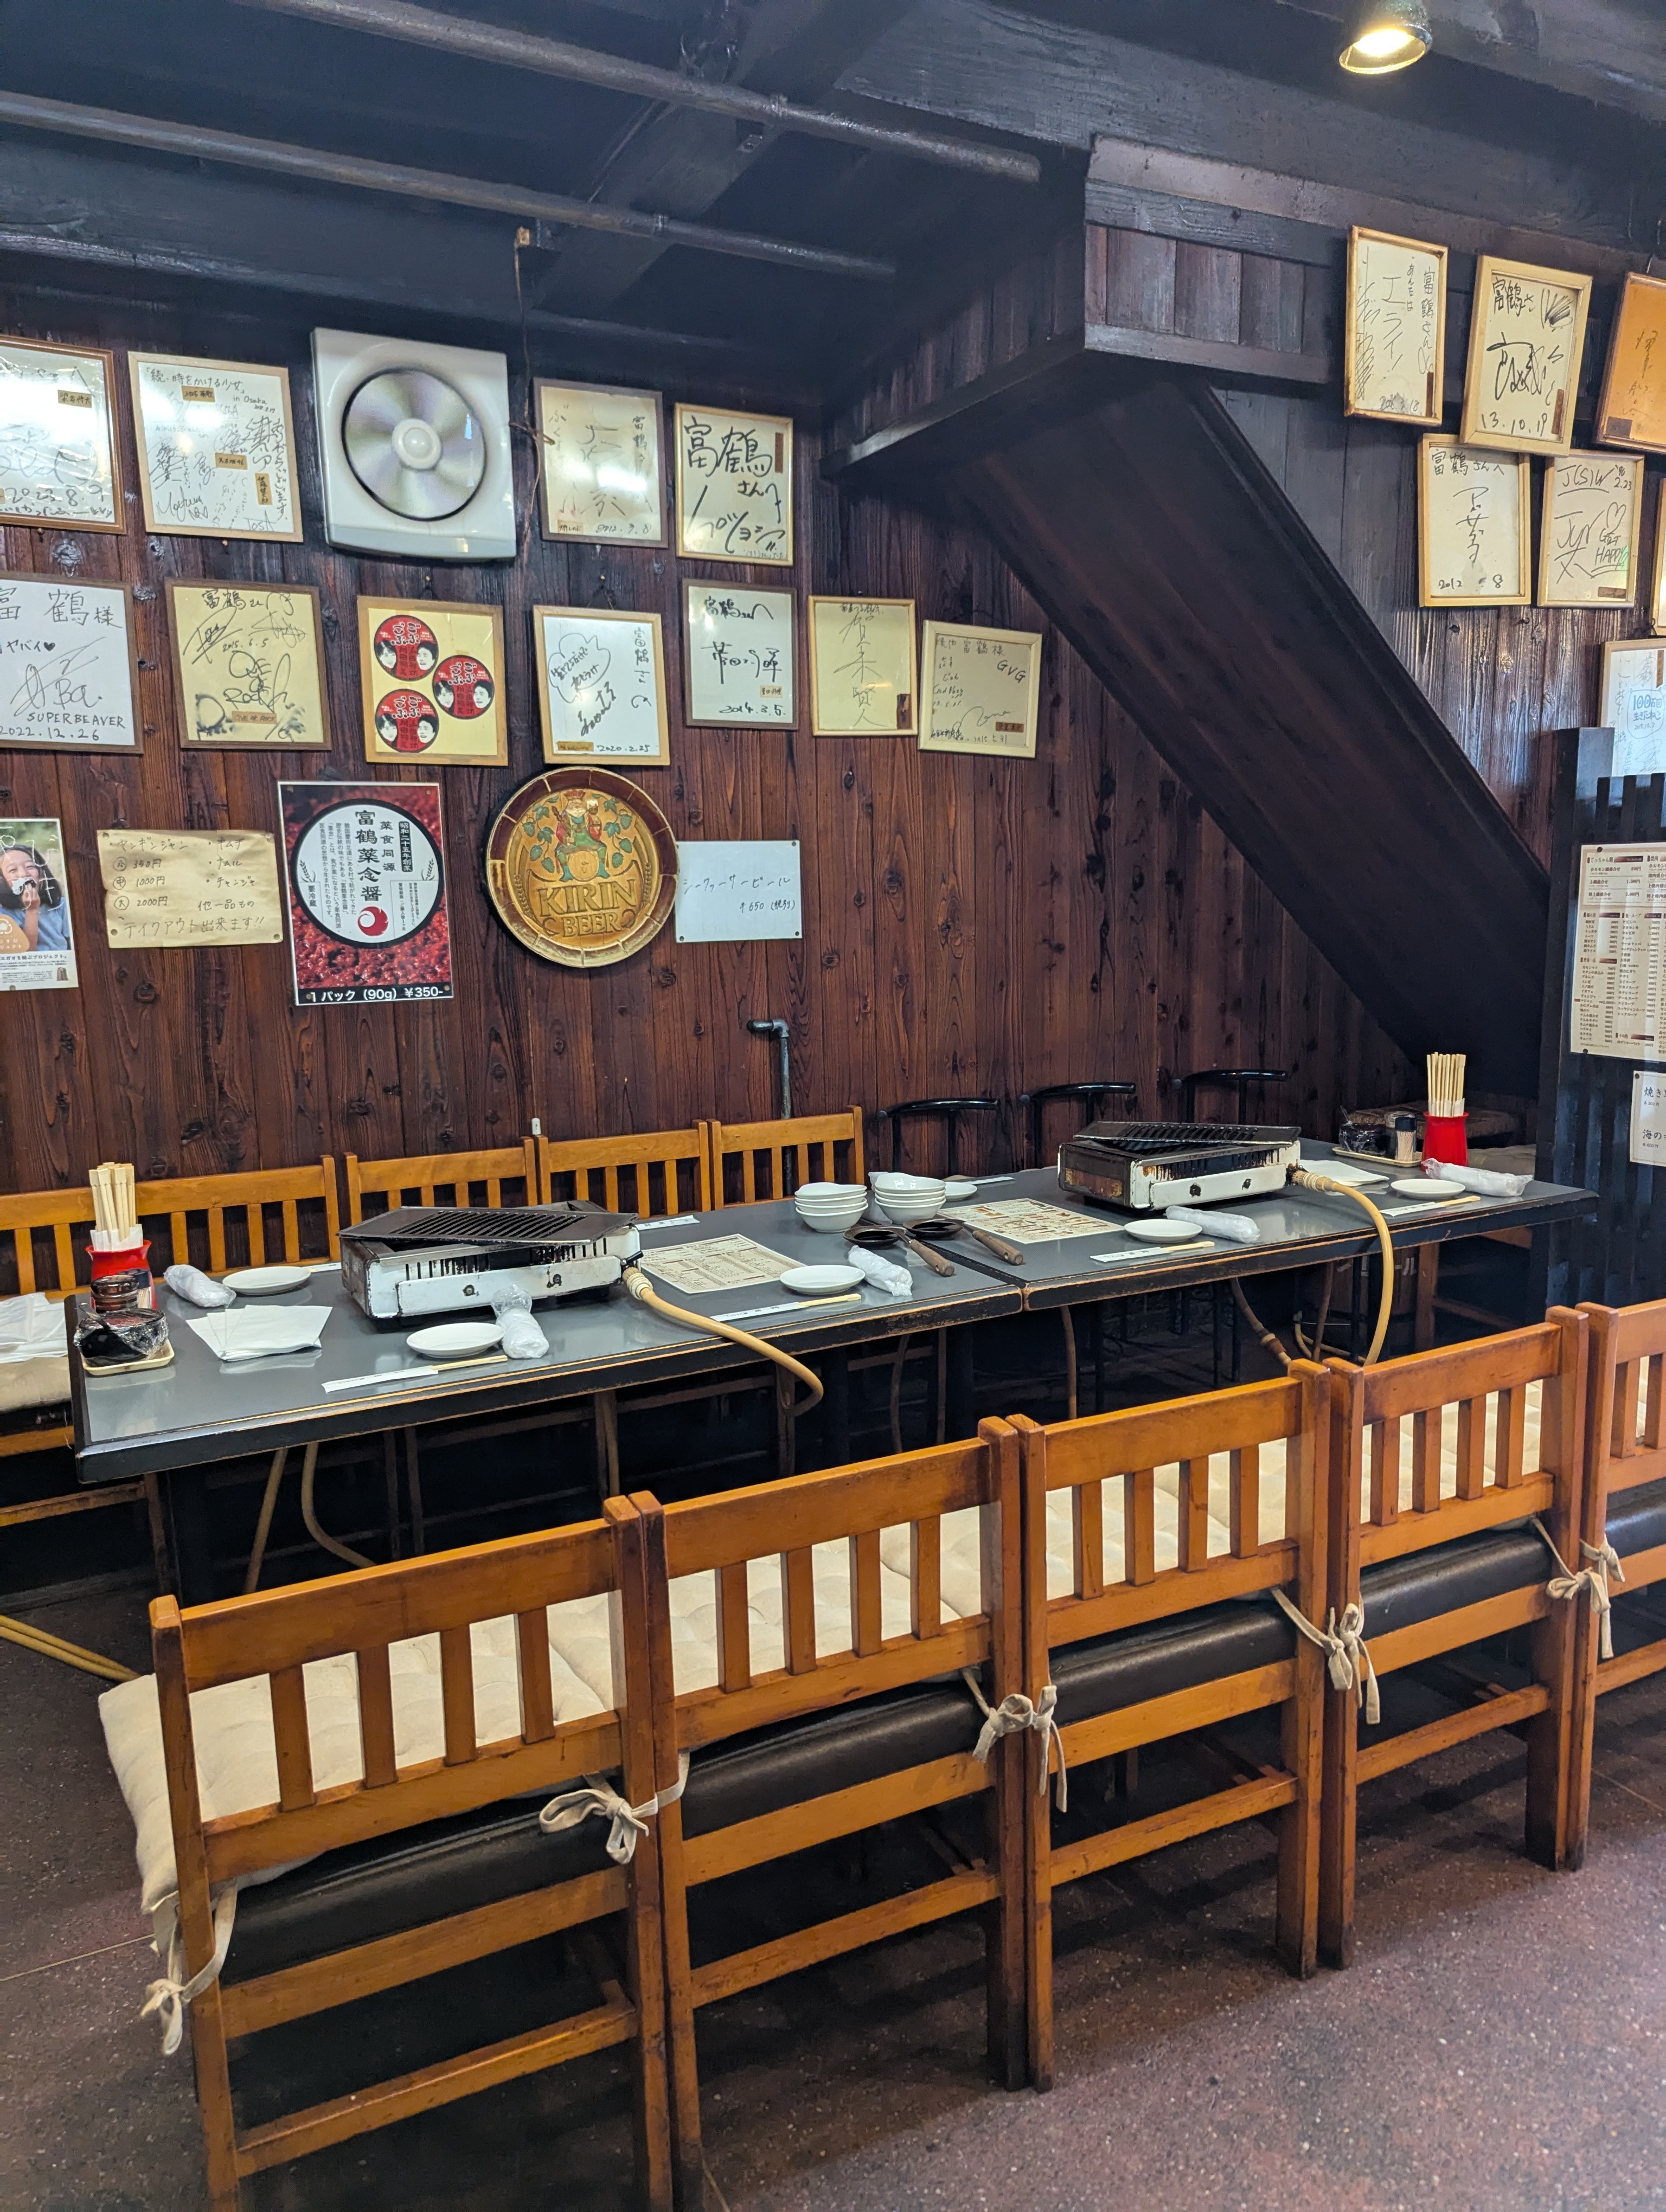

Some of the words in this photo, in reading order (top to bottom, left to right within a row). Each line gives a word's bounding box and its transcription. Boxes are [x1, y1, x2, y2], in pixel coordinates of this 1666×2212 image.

[355, 810, 383, 903] 富鶴薬念醤
[380, 821, 396, 872] 薬食同源
[136, 876, 165, 888] 1000円
[217, 876, 256, 888] チャンジャ
[137, 896, 168, 907] 2000円
[198, 900, 254, 912] 他一品もの
[307, 885, 317, 908] 要冷蔵
[537, 879, 637, 916] KIRIN
[561, 910, 622, 938] BEER
